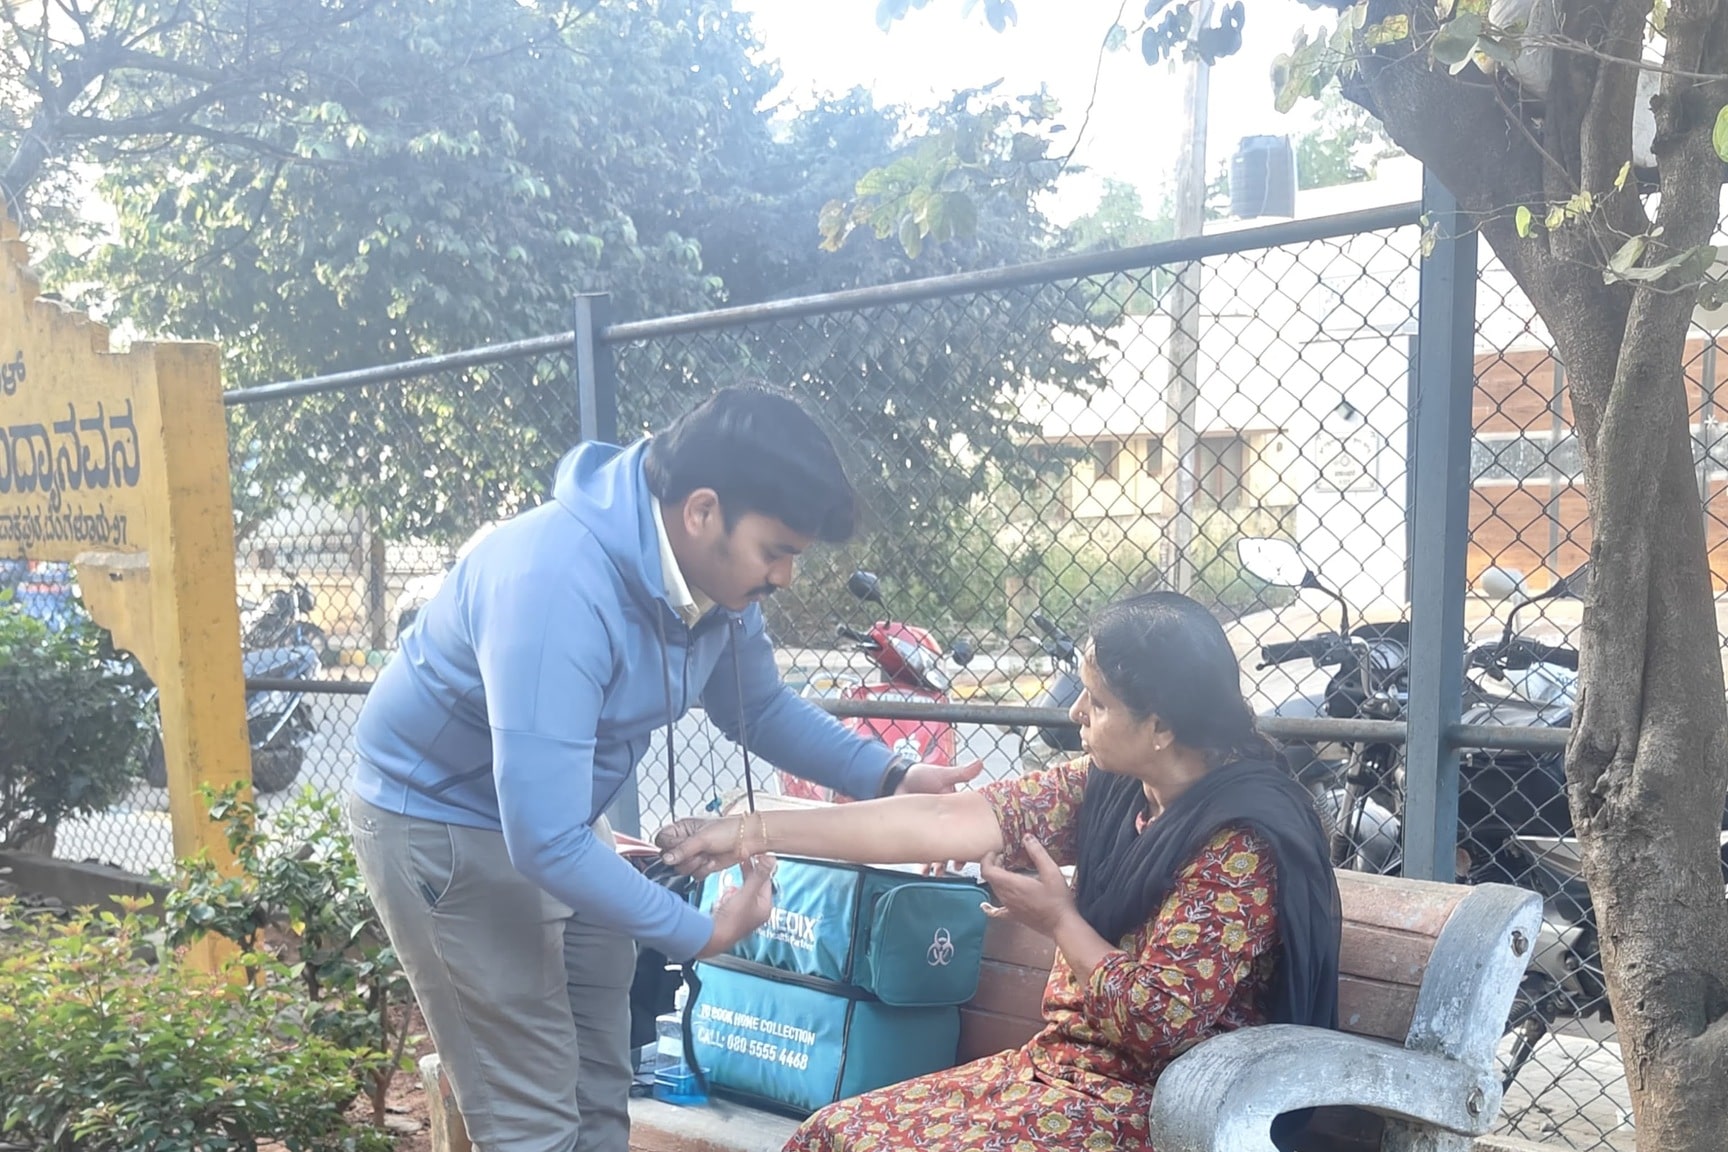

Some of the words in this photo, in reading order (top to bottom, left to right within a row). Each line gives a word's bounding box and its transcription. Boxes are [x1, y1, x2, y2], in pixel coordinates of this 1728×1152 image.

[711, 1006, 734, 1024] BOOK
[734, 1011, 760, 1030] HOME
[760, 1019, 816, 1046] COLLECTION
[697, 1026, 725, 1048] CALL:
[726, 1033, 747, 1055] 080
[749, 1039, 778, 1062] 5555
[779, 1047, 809, 1071] 4468
